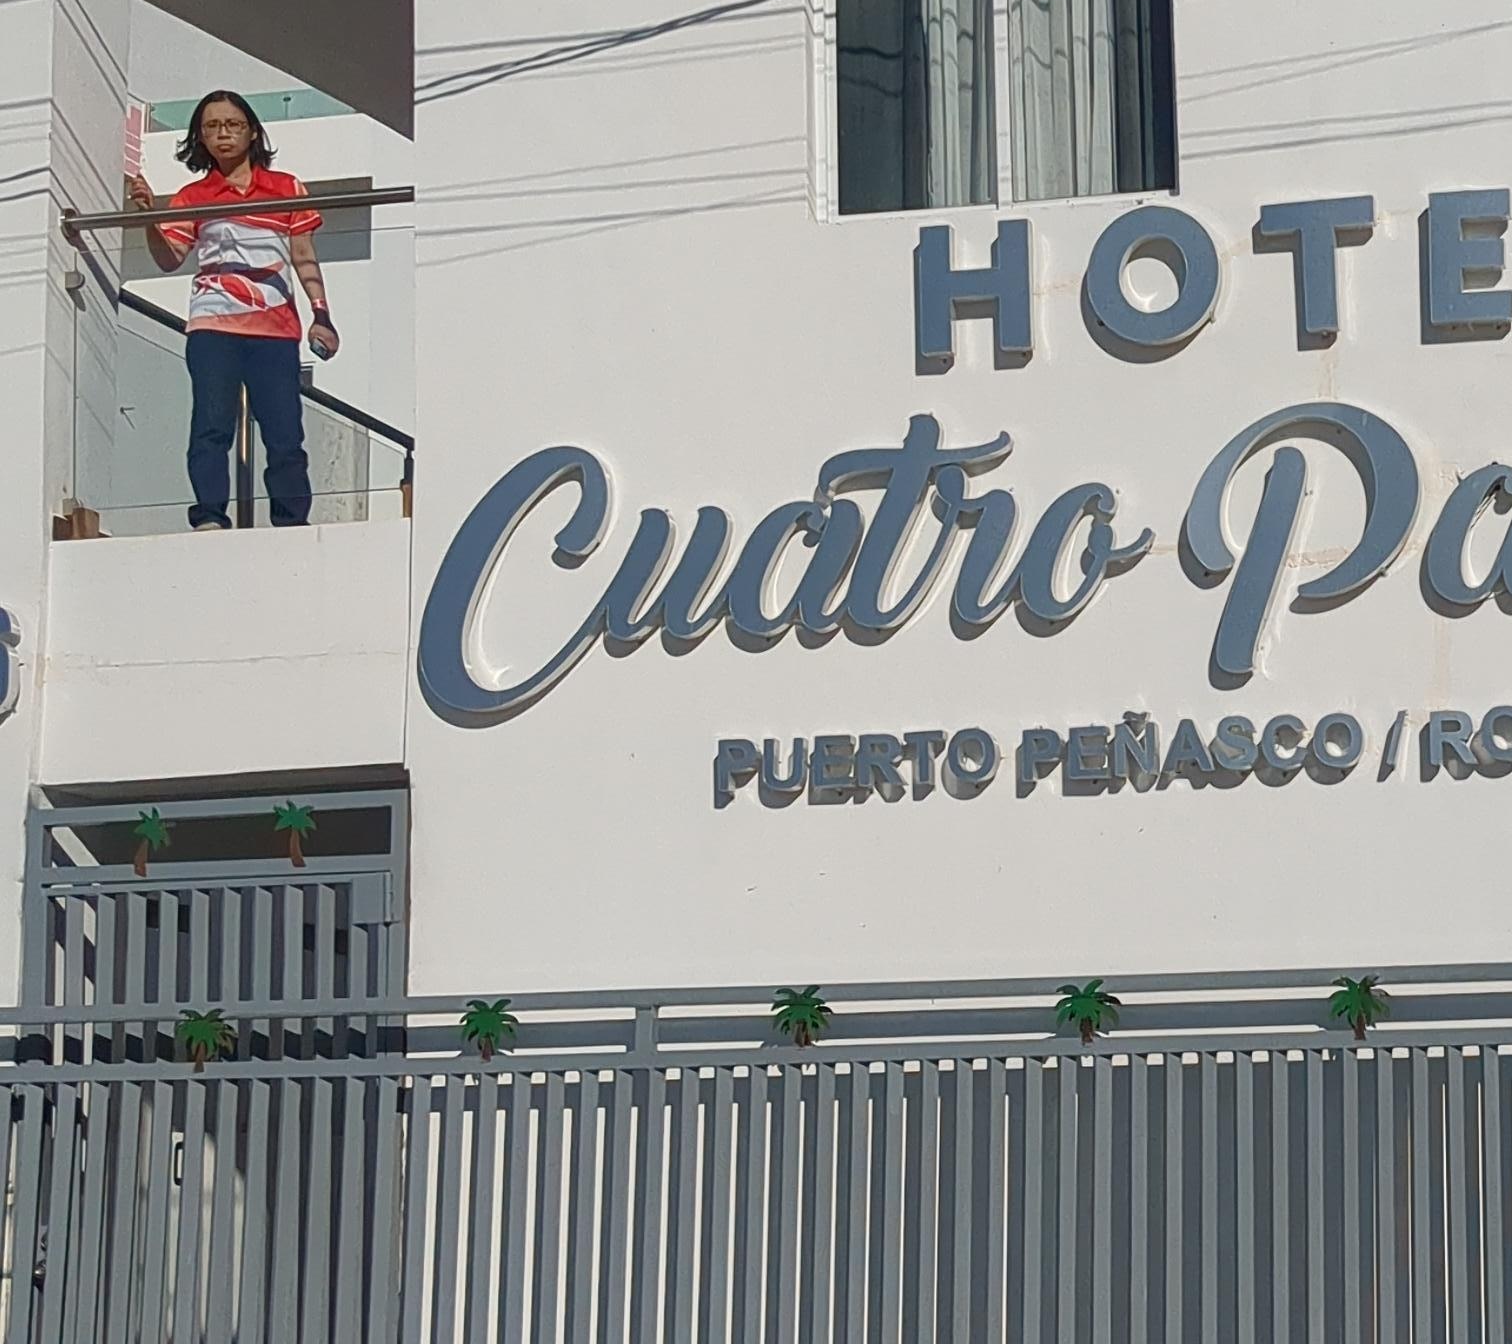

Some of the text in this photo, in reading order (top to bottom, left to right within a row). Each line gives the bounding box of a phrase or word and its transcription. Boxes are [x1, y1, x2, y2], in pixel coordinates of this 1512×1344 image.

[418, 412, 1156, 718] Cuatro
[714, 727, 1000, 799] PUERTO
[1019, 712, 1364, 790] PEÑASCO
[1380, 708, 1408, 776] /
